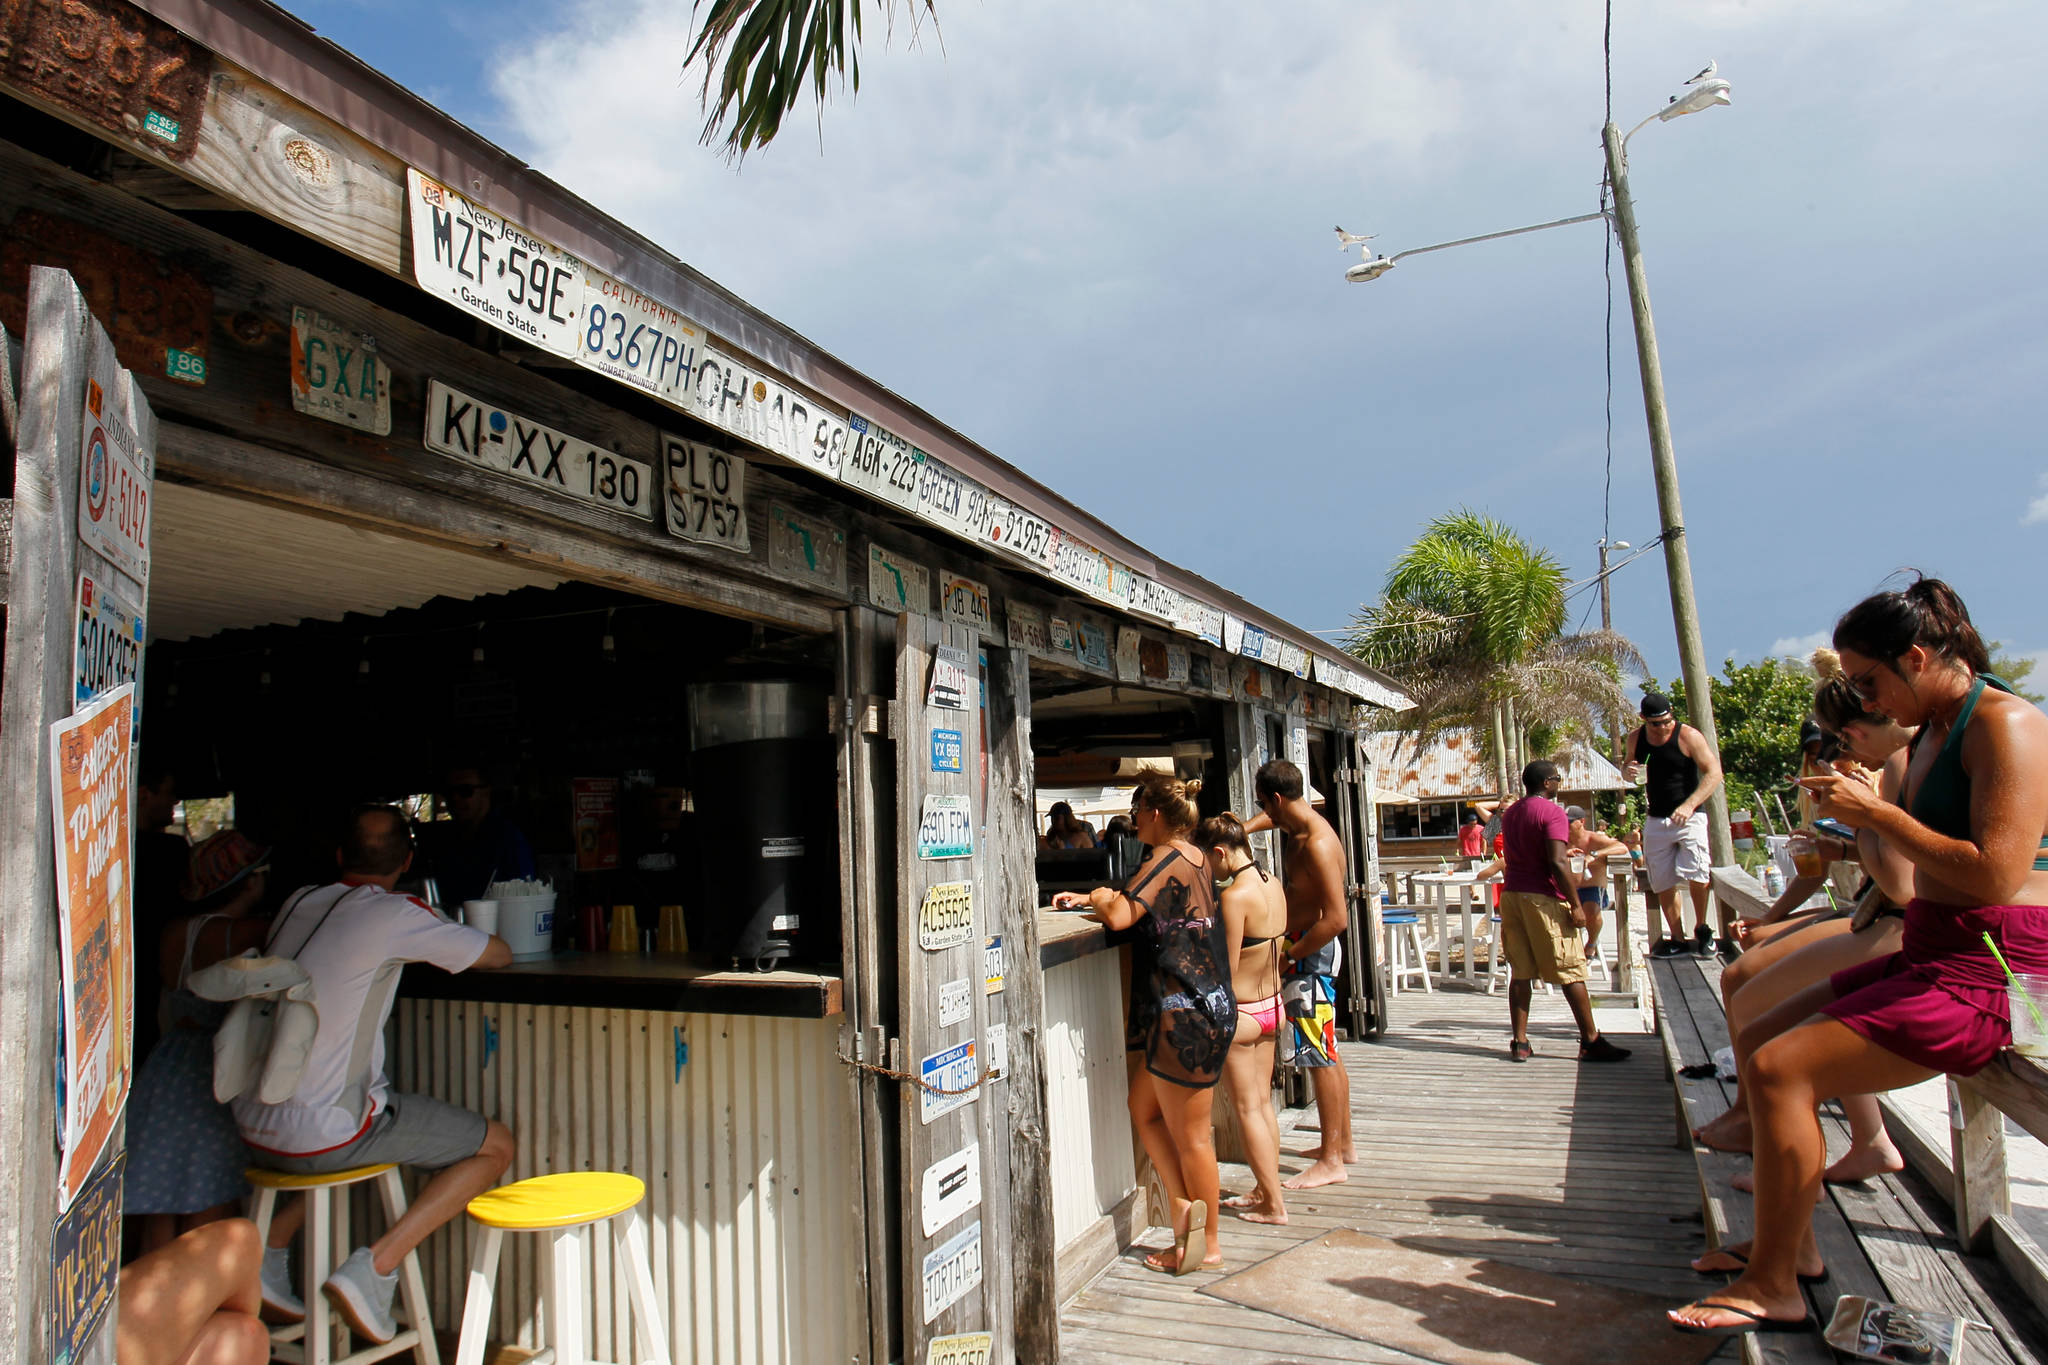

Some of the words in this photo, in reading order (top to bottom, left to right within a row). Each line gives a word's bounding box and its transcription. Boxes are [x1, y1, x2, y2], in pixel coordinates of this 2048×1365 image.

[158, 116, 178, 131] SEP
[461, 198, 497, 231] New
[498, 219, 547, 255] Jersey
[432, 206, 495, 286] MZF
[508, 247, 572, 325] 59E
[461, 286, 503, 320] Garden
[507, 311, 537, 336] State
[602, 280, 679, 328] CALIFORNIA
[177, 353, 204, 375] 86
[305, 337, 377, 404] GXA
[586, 303, 695, 391] 8367PH
[598, 361, 625, 380] COMBAT
[626, 373, 658, 392] WOUNDED
[108, 412, 136, 462] INDIANA
[854, 416, 867, 430] FEB
[875, 427, 908, 451] TEXAS
[586, 451, 639, 507] 130
[668, 442, 730, 495] PLO
[851, 433, 885, 478] AGK
[889, 451, 918, 493] 223
[118, 466, 147, 551] 5142
[920, 465, 963, 517] GREEN
[79, 717, 119, 791] CHEERS
[69, 803, 89, 854] TO
[91, 752, 125, 830] WHAT'S
[922, 811, 946, 845] 690
[949, 811, 972, 846] FPM
[86, 805, 119, 890] AHEAD
[934, 936, 951, 945] Garden
[951, 933, 963, 942] State
[936, 1047, 964, 1067] MICHIGAN
